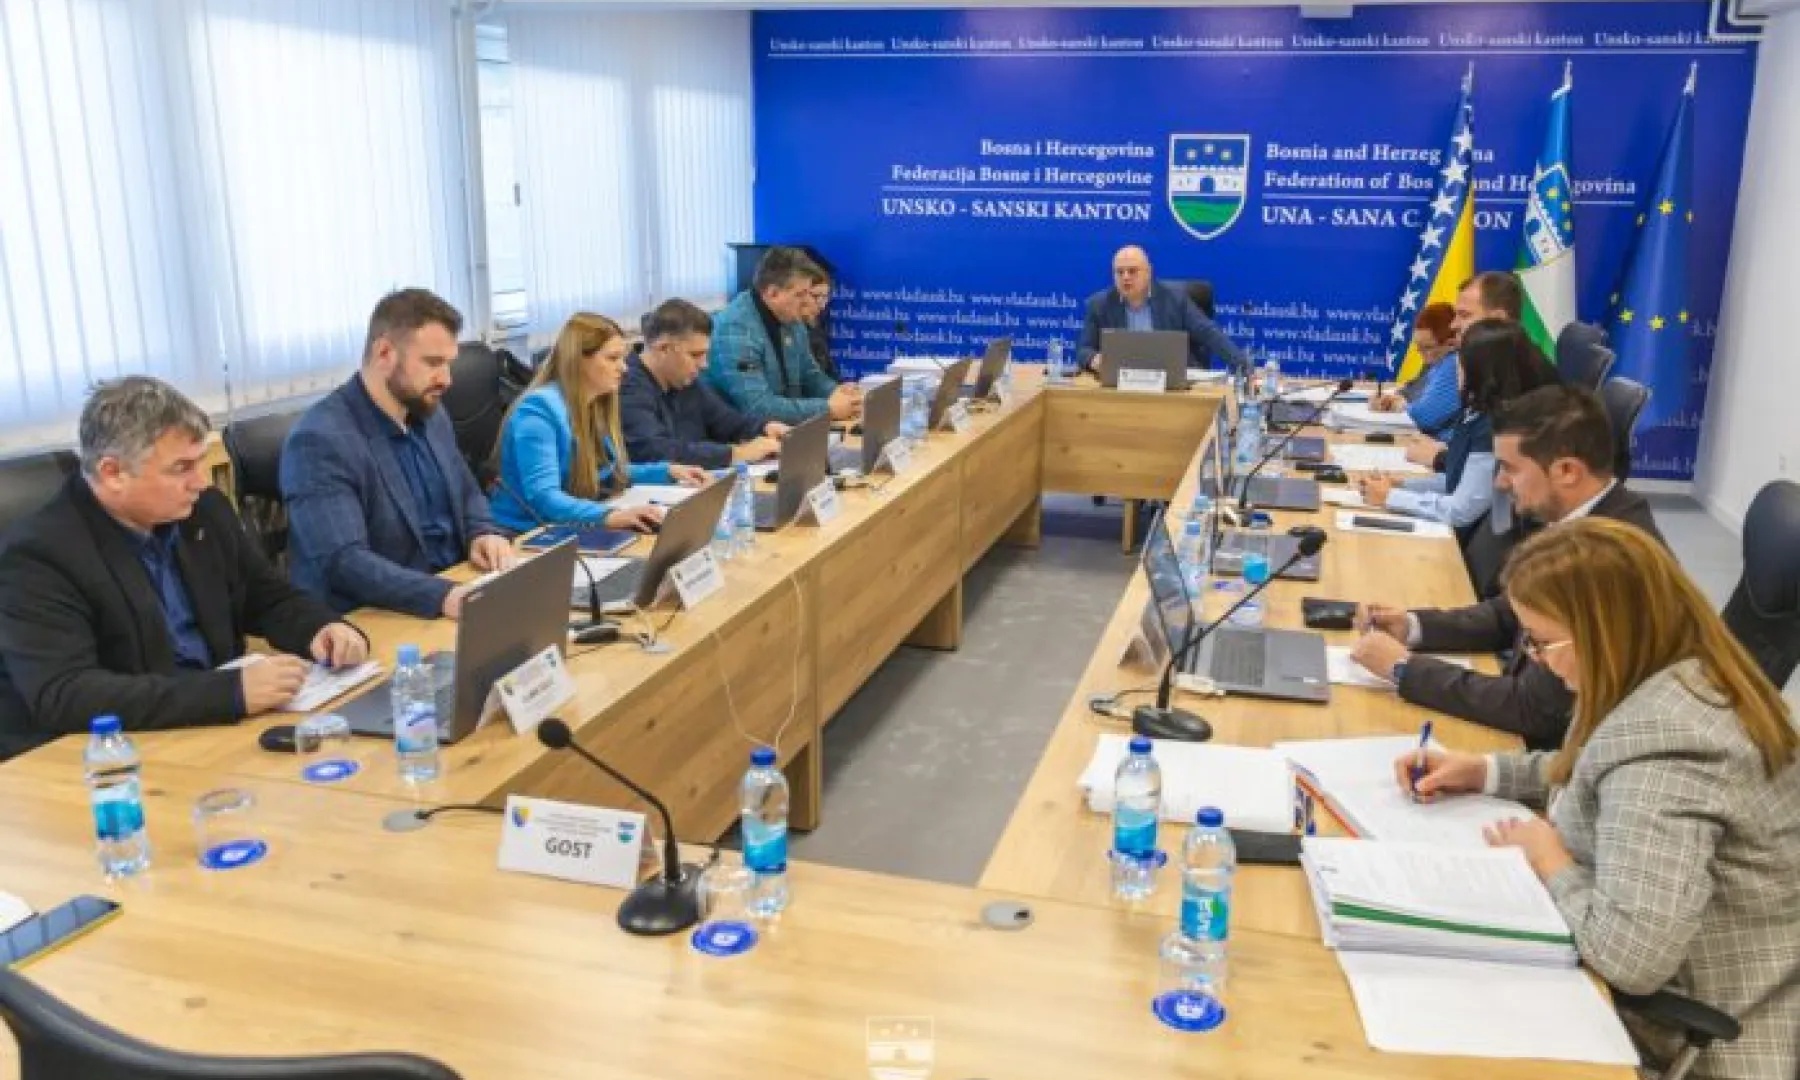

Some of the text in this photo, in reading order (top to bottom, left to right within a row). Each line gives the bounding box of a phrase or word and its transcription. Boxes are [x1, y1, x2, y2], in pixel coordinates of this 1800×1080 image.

[980, 139, 1154, 161] Bosna i Hercegovina
[1266, 143, 1495, 166] Bosnia and Herzegna
[891, 164, 1154, 189] Federacija Bosne i Hercegovine
[1264, 171, 1365, 189] Federation
[1370, 173, 1392, 189] of
[1398, 173, 1434, 189] Bos
[1509, 174, 1637, 196] Hegovina
[883, 198, 955, 215] UNSKO
[971, 201, 1049, 219] SANSKI
[1053, 203, 1151, 220] KANTON
[1262, 206, 1314, 225] UNA
[1331, 208, 1396, 227] SANA
[545, 836, 593, 858] GOST
